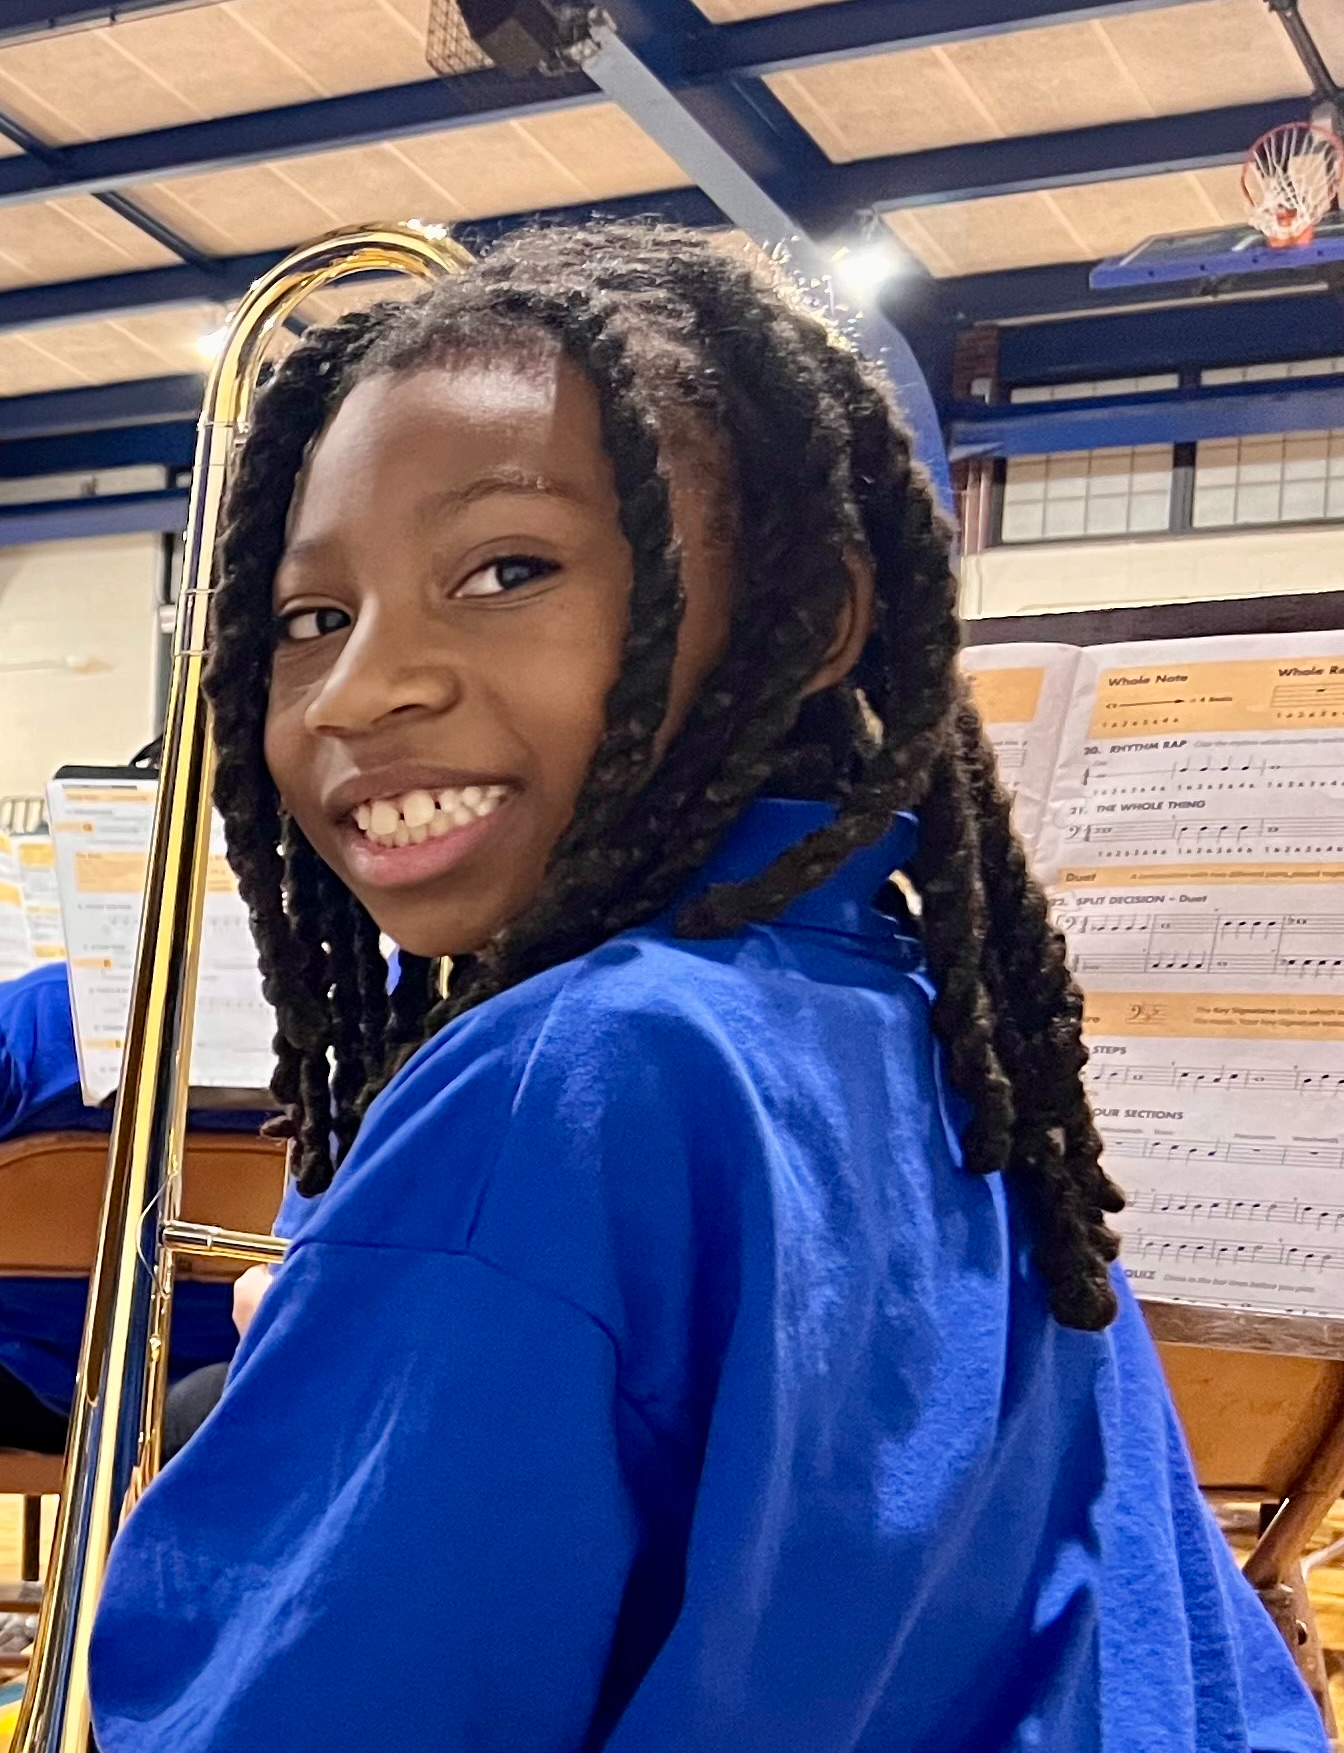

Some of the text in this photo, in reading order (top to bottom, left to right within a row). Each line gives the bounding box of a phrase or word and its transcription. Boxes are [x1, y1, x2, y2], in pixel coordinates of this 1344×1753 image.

[1278, 665, 1323, 677] Whole
[1108, 674, 1188, 687] Whole Note
[1110, 741, 1159, 754] RHYTHM
[1163, 739, 1188, 749] RAP
[1097, 803, 1115, 814] THE
[1120, 801, 1163, 812] WHOLE
[1168, 800, 1206, 810] THING
[1065, 872, 1097, 883] Duet
[1076, 896, 1106, 905] SPLIT
[1109, 895, 1166, 905] DECISION
[1179, 894, 1208, 904] Duet
[1092, 1045, 1127, 1055] STEPS
[1125, 1108, 1184, 1120] SECTIONS
[1124, 1268, 1156, 1280] QUIZ
